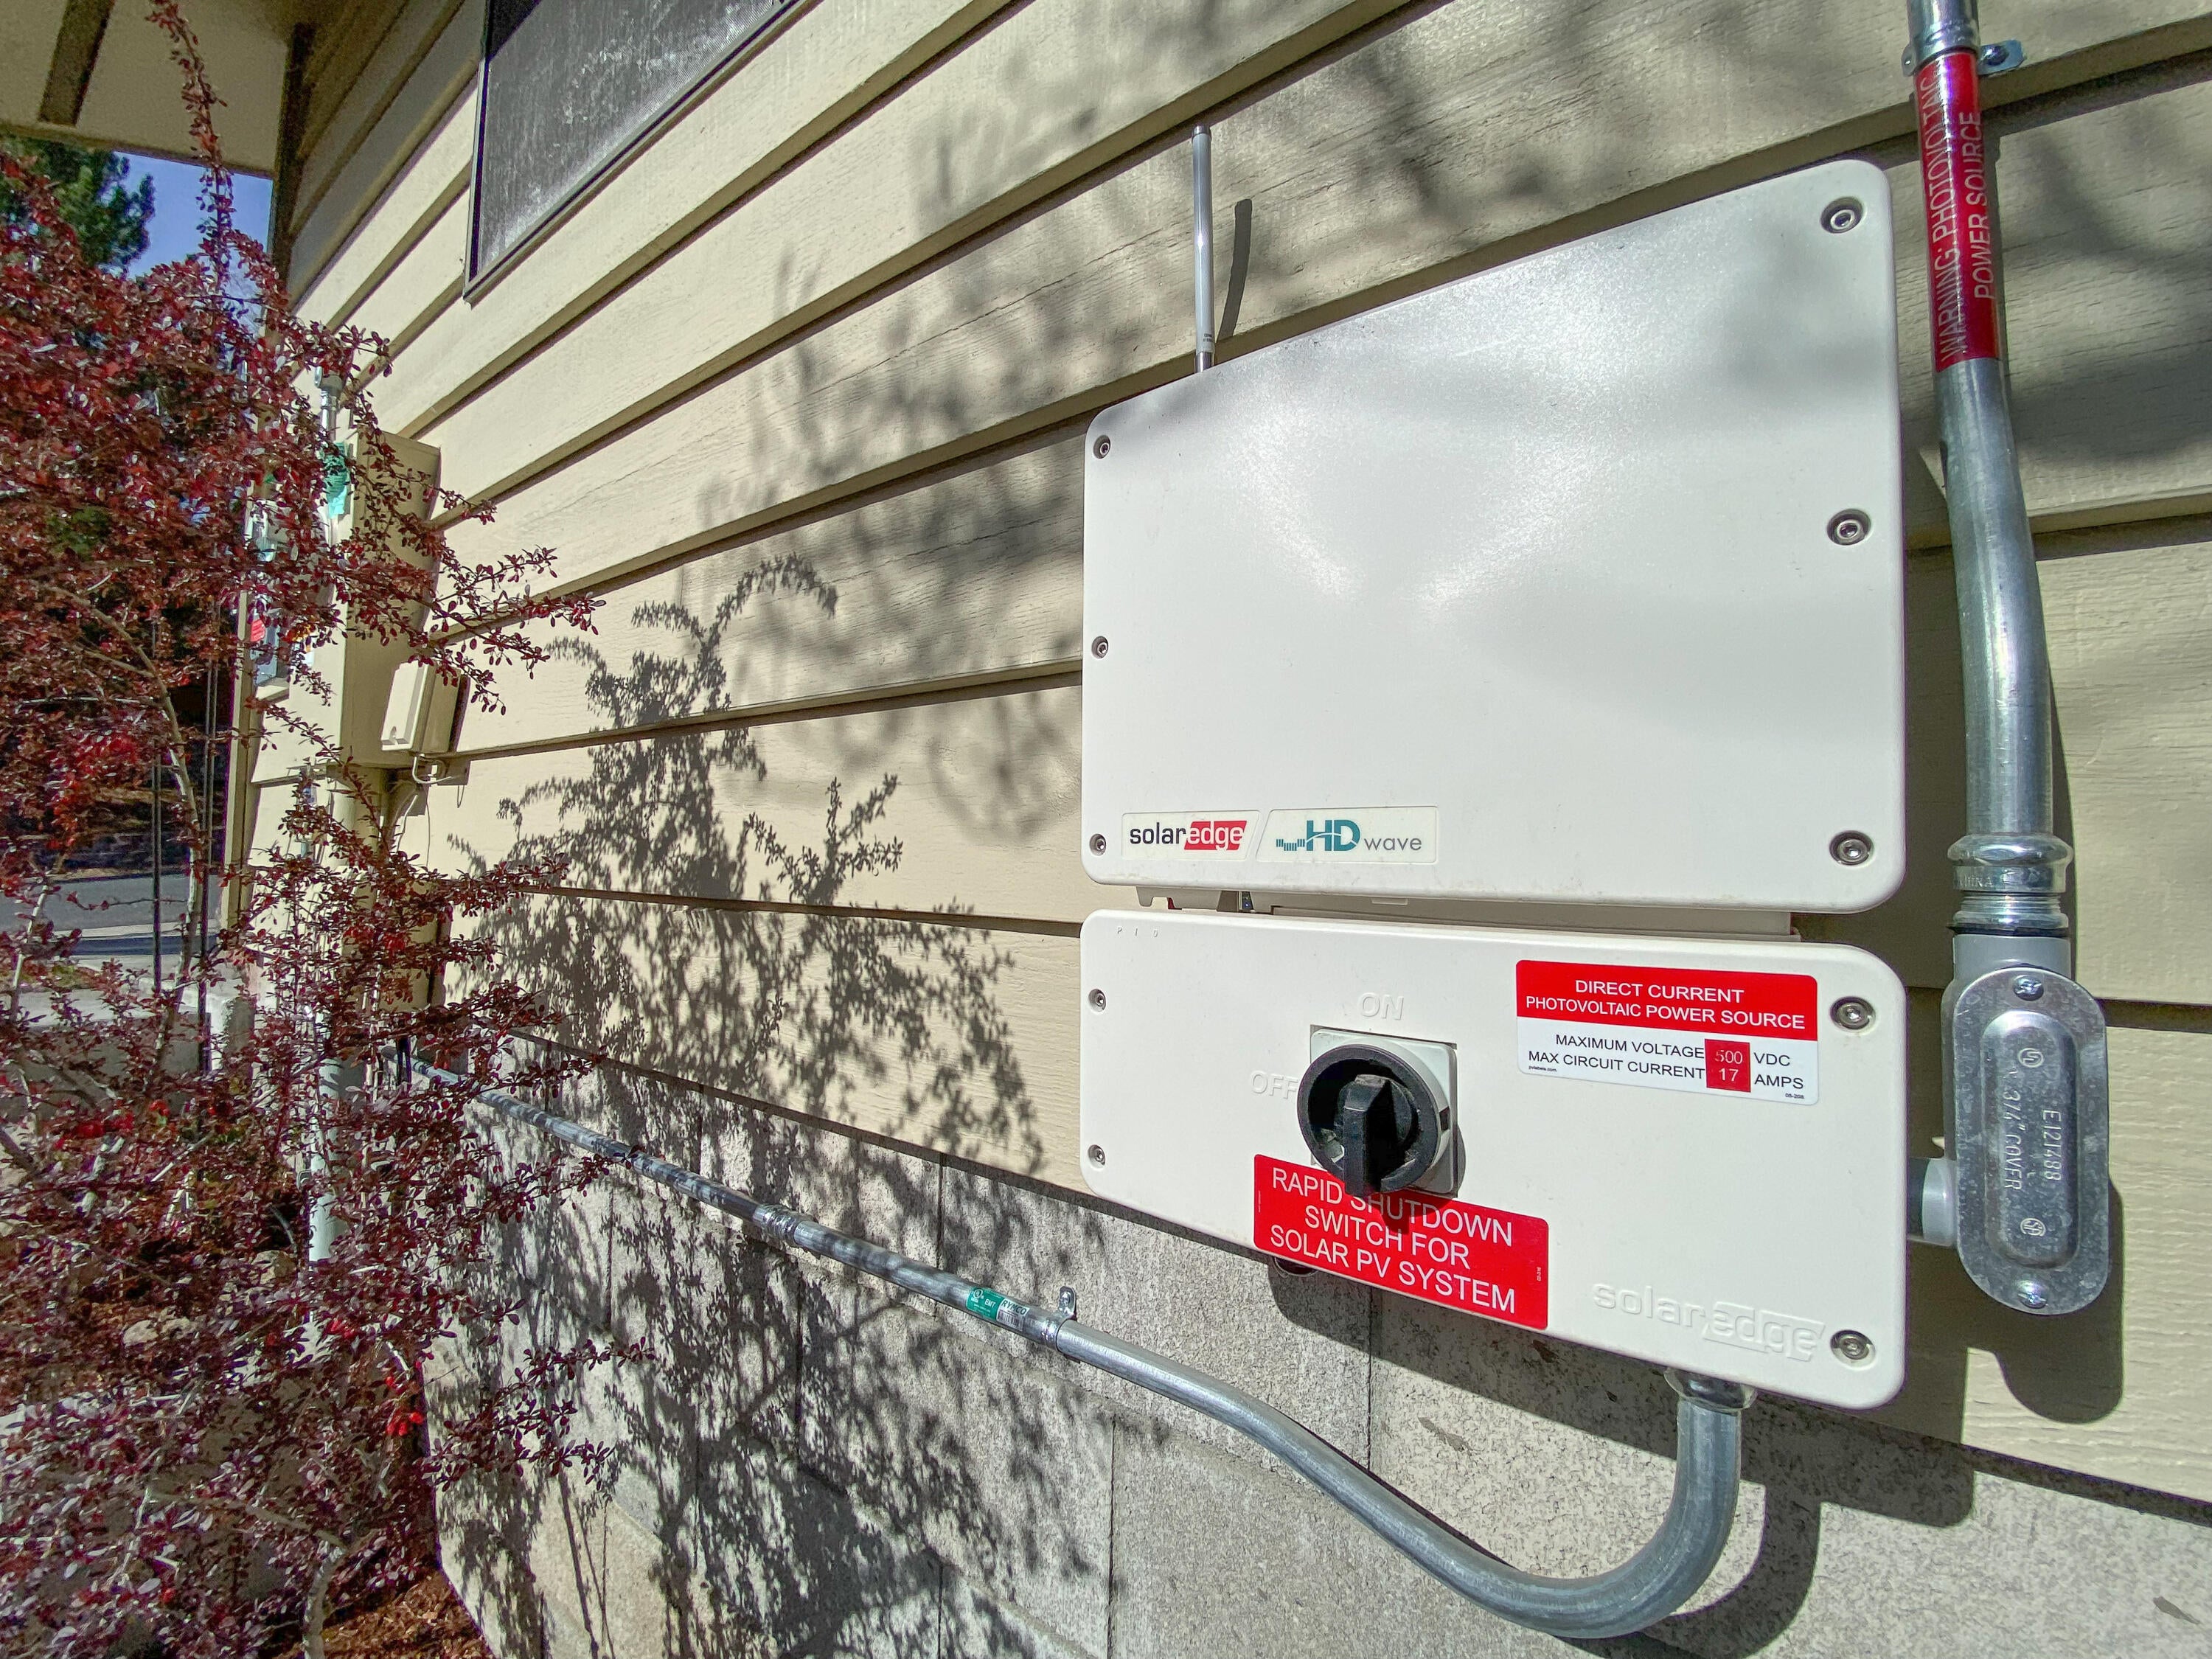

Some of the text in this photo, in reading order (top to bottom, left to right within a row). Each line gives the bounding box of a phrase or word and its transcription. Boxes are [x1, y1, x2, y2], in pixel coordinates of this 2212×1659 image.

[1920, 72, 1967, 362] WARNING: PHOTOVOLTAIC
[1959, 111, 1995, 299] POWER SOURCE
[1130, 819, 1422, 852] solaredge HD wave
[1358, 992, 1405, 1021] ON
[1575, 980, 1745, 1004] DIRECT CURRENT
[1526, 996, 1806, 1030] PHOTOVOLTAIC POWER SOURCE
[1528, 1050, 1804, 1090] MAX CIRCUIT CURRENT 17 AMPS
[1556, 1034, 1791, 1067] MAXIMUM VOLTAGE 500 VDC
[1251, 1070, 1298, 1099] OFF
[2004, 1134, 2022, 1189] COVER
[2042, 1109, 2062, 1180] E121488
[1272, 1167, 1343, 1205] RAPID
[1304, 1205, 1471, 1270] SWITCH FOR
[1270, 1224, 1515, 1314] SOLAR PV SYSTEM
[984, 1298, 996, 1308] EMT
[1001, 1300, 1027, 1315] RYMCO
[1593, 1283, 1821, 1361] solaredge
